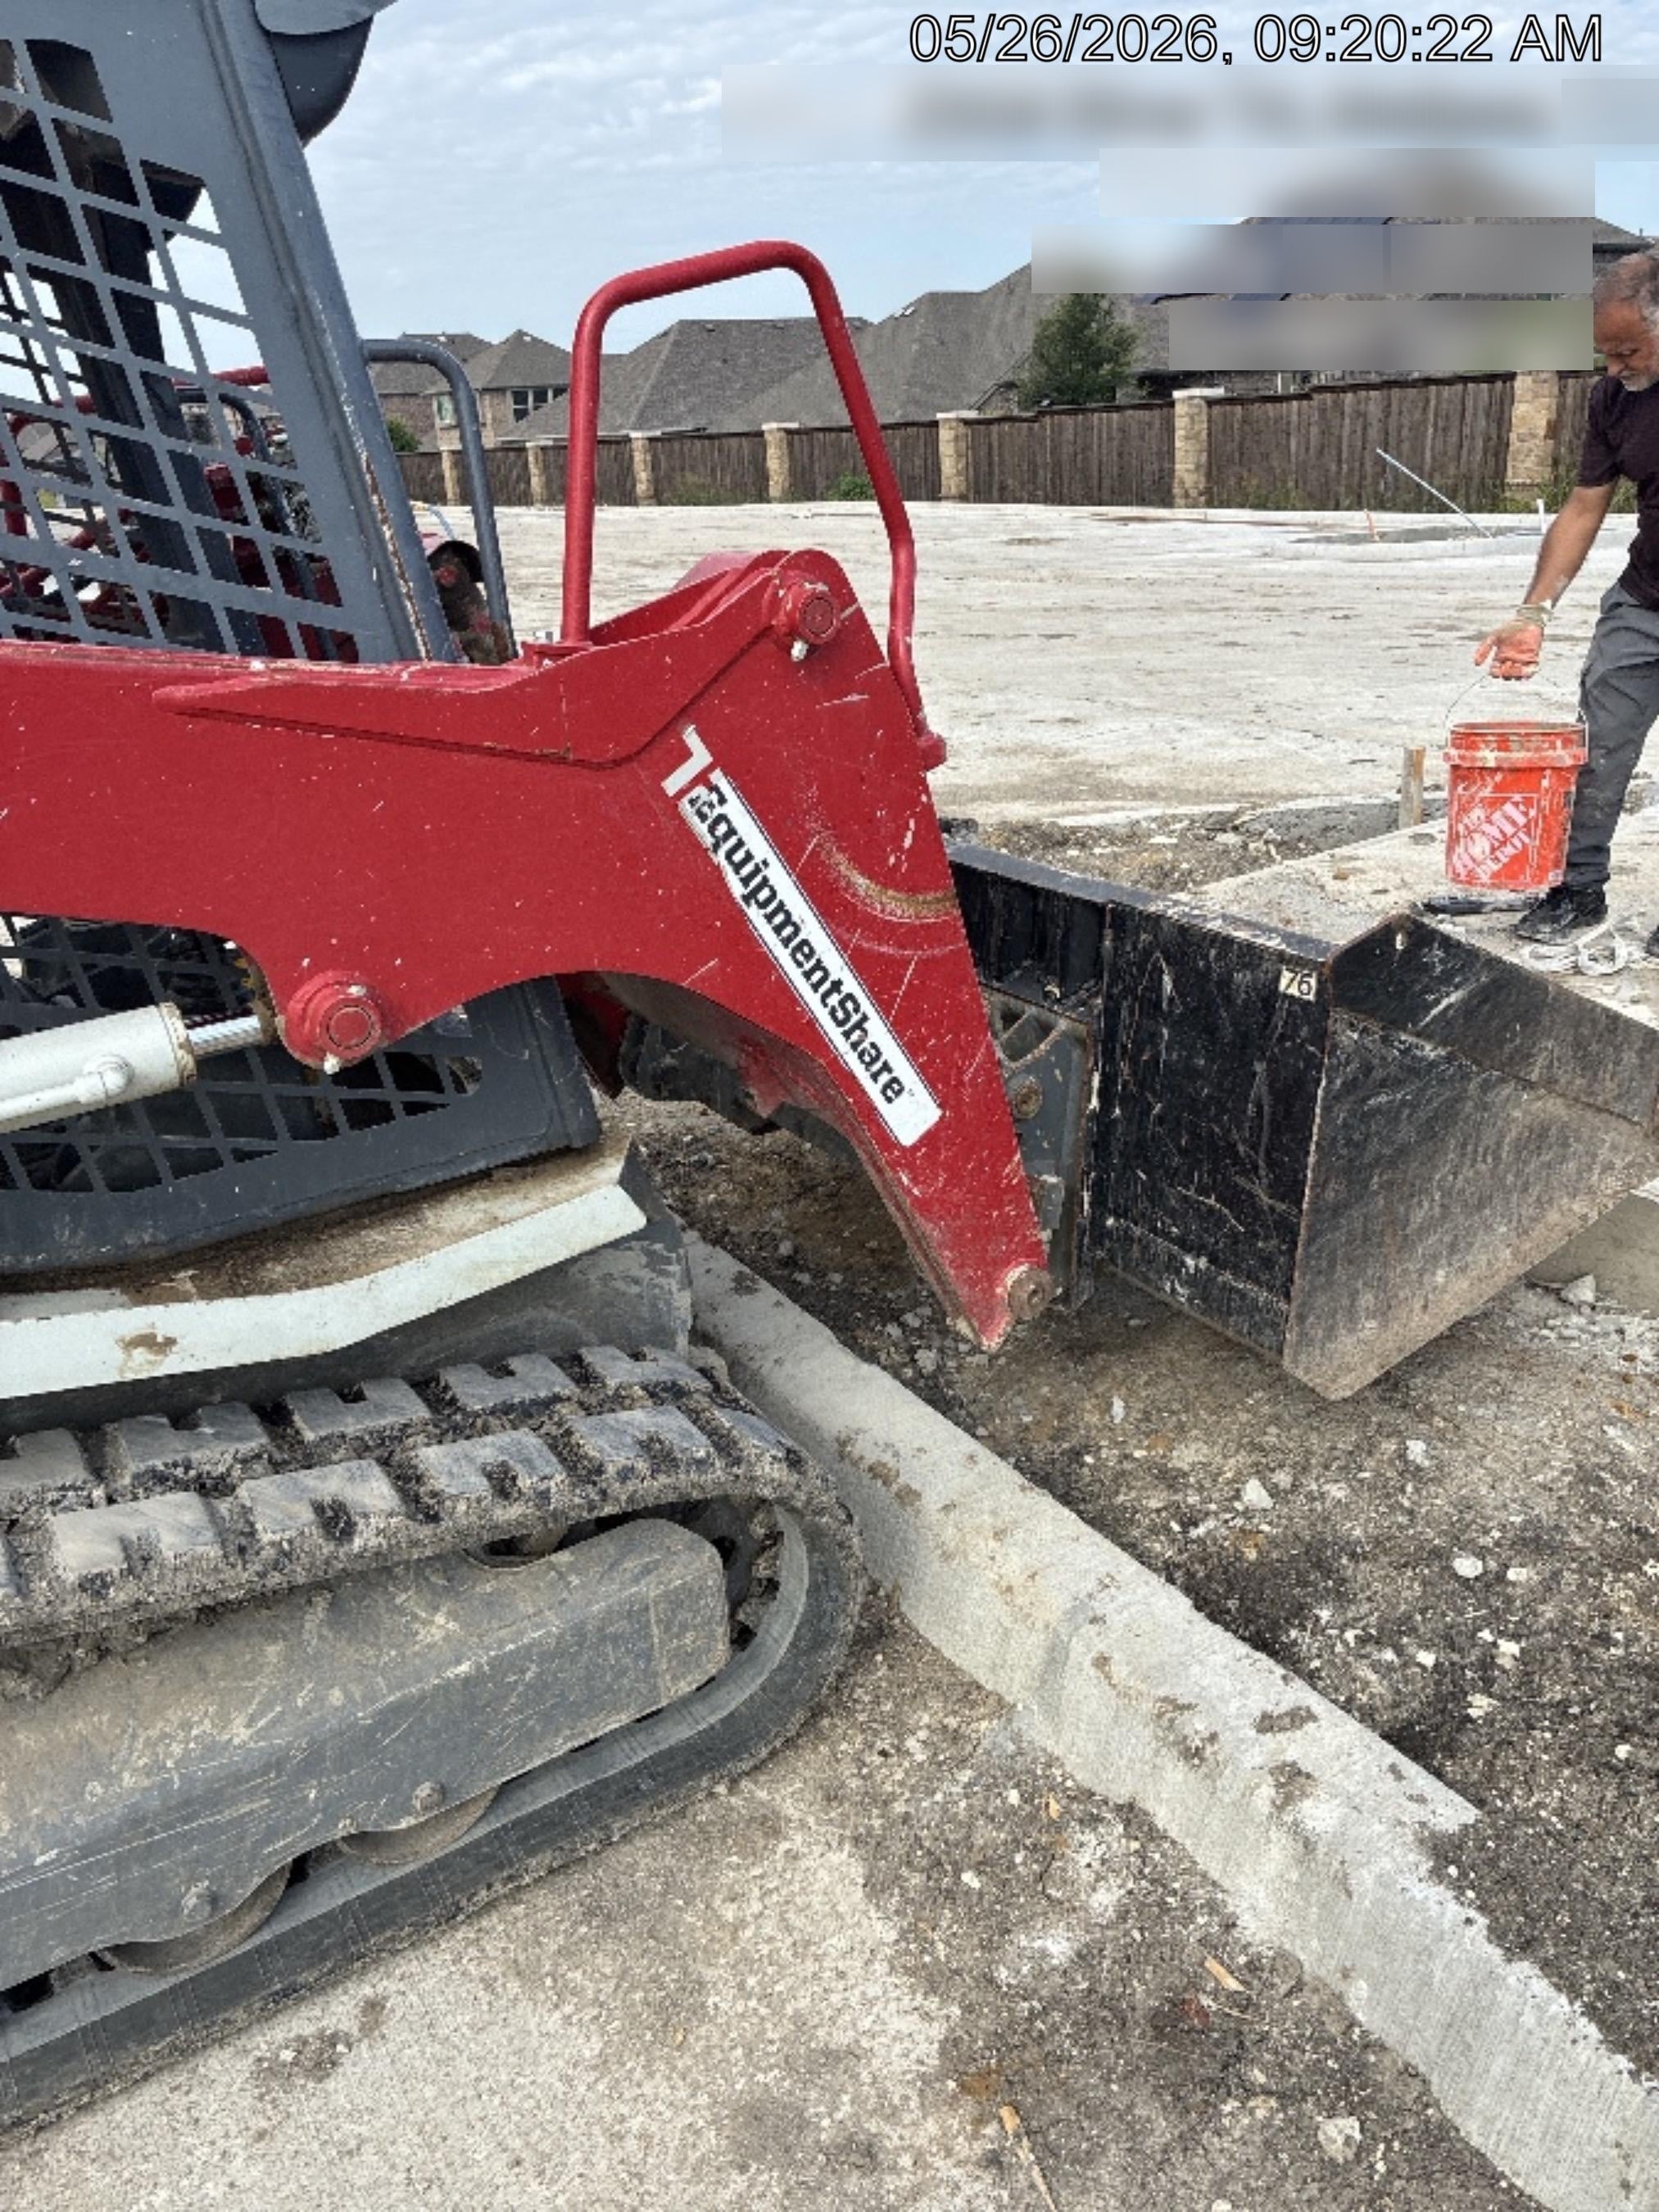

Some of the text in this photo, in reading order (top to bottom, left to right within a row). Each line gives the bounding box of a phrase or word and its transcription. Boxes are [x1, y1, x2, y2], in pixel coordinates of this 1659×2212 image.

[1453, 796, 1535, 880] HOME
[1474, 830, 1531, 881] DEPOT
[687, 781, 904, 1105] EquipmentShare
[1284, 968, 1312, 997] 76
